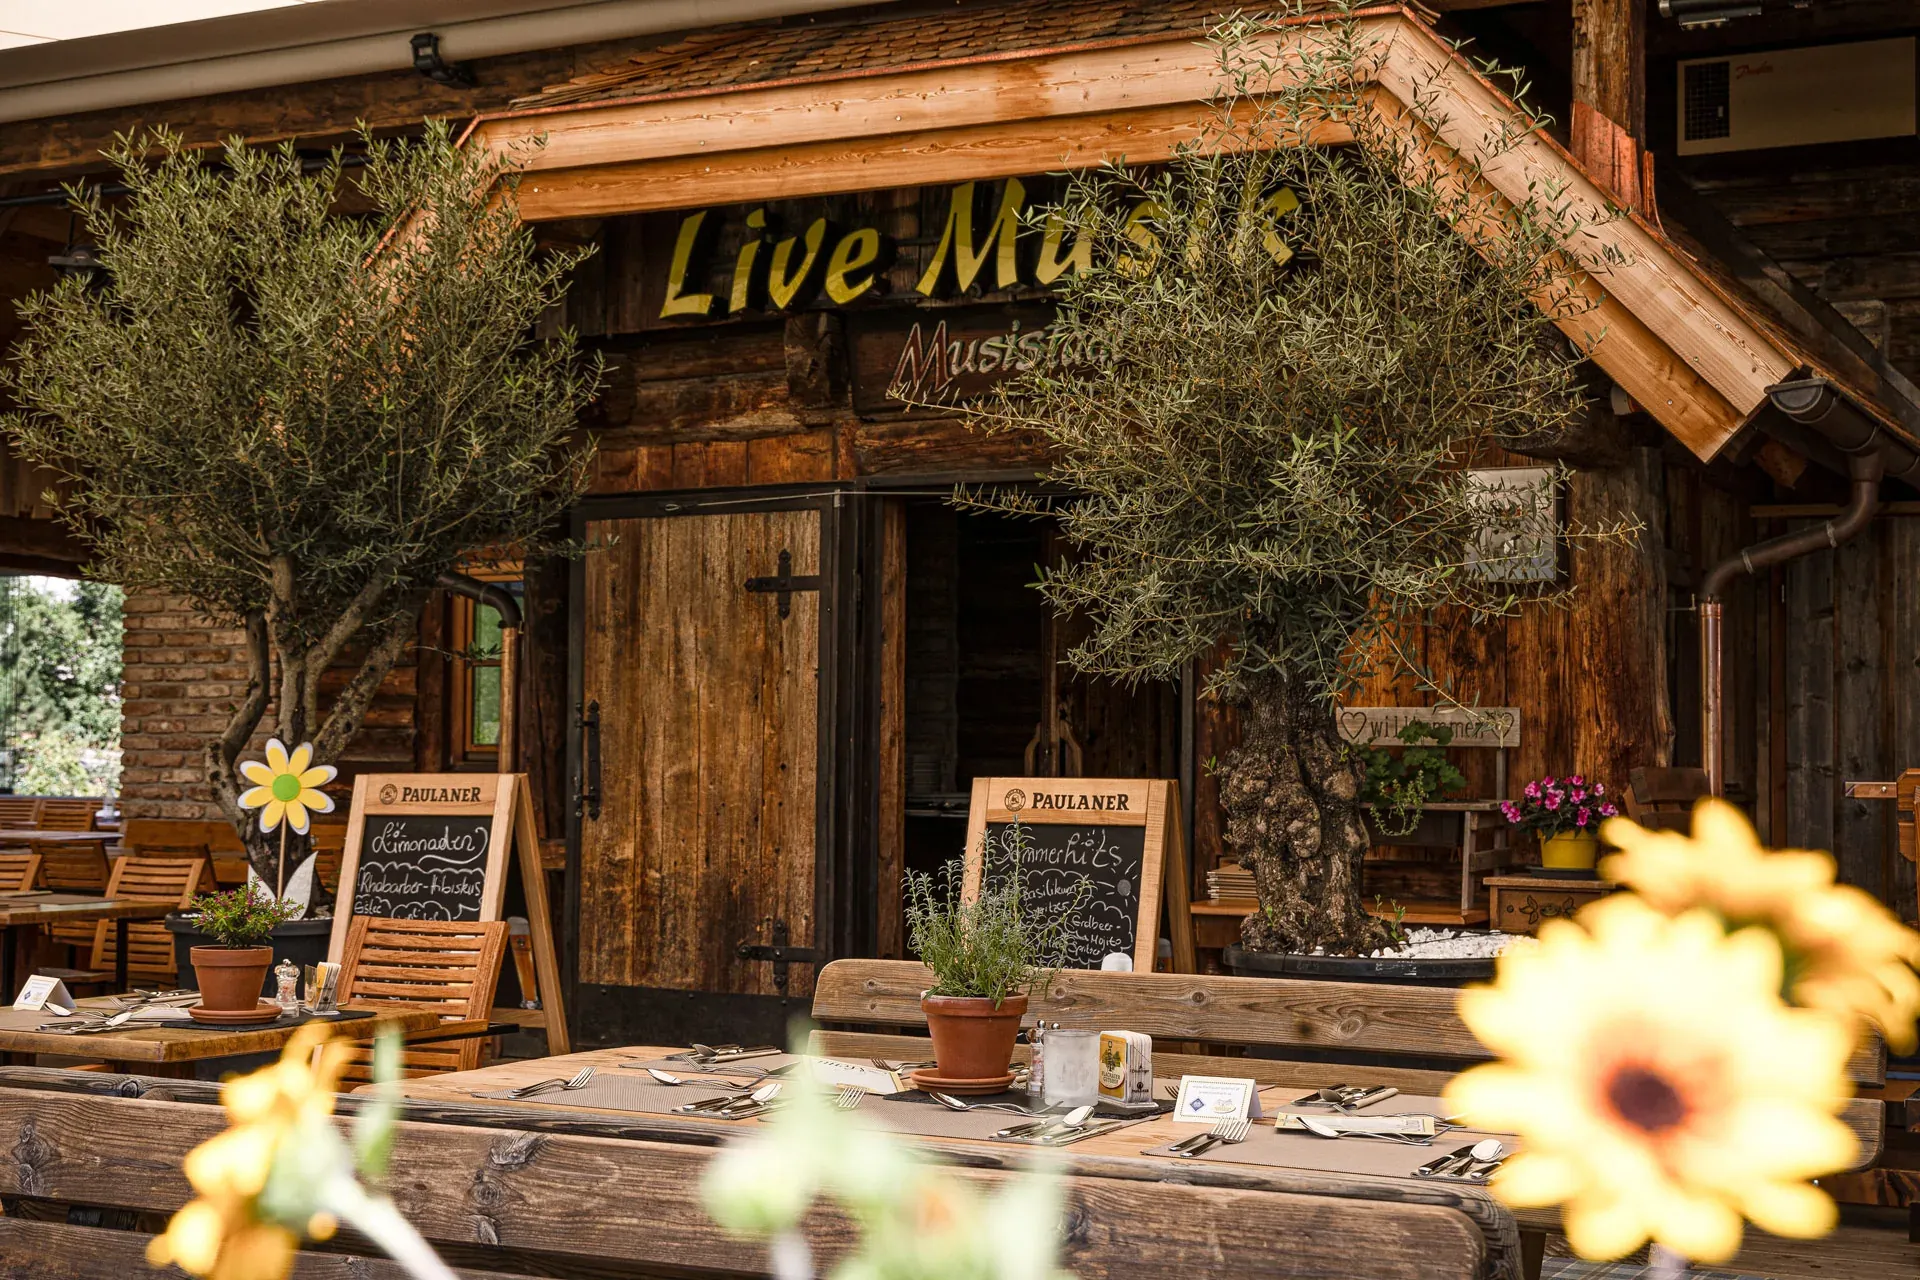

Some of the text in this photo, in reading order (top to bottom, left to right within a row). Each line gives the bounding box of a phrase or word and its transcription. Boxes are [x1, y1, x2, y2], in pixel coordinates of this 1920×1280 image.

[659, 207, 881, 319] Live
[402, 786, 481, 802] PAULANER
[1032, 792, 1130, 810] PAULANER
[372, 821, 476, 854] Limonaden
